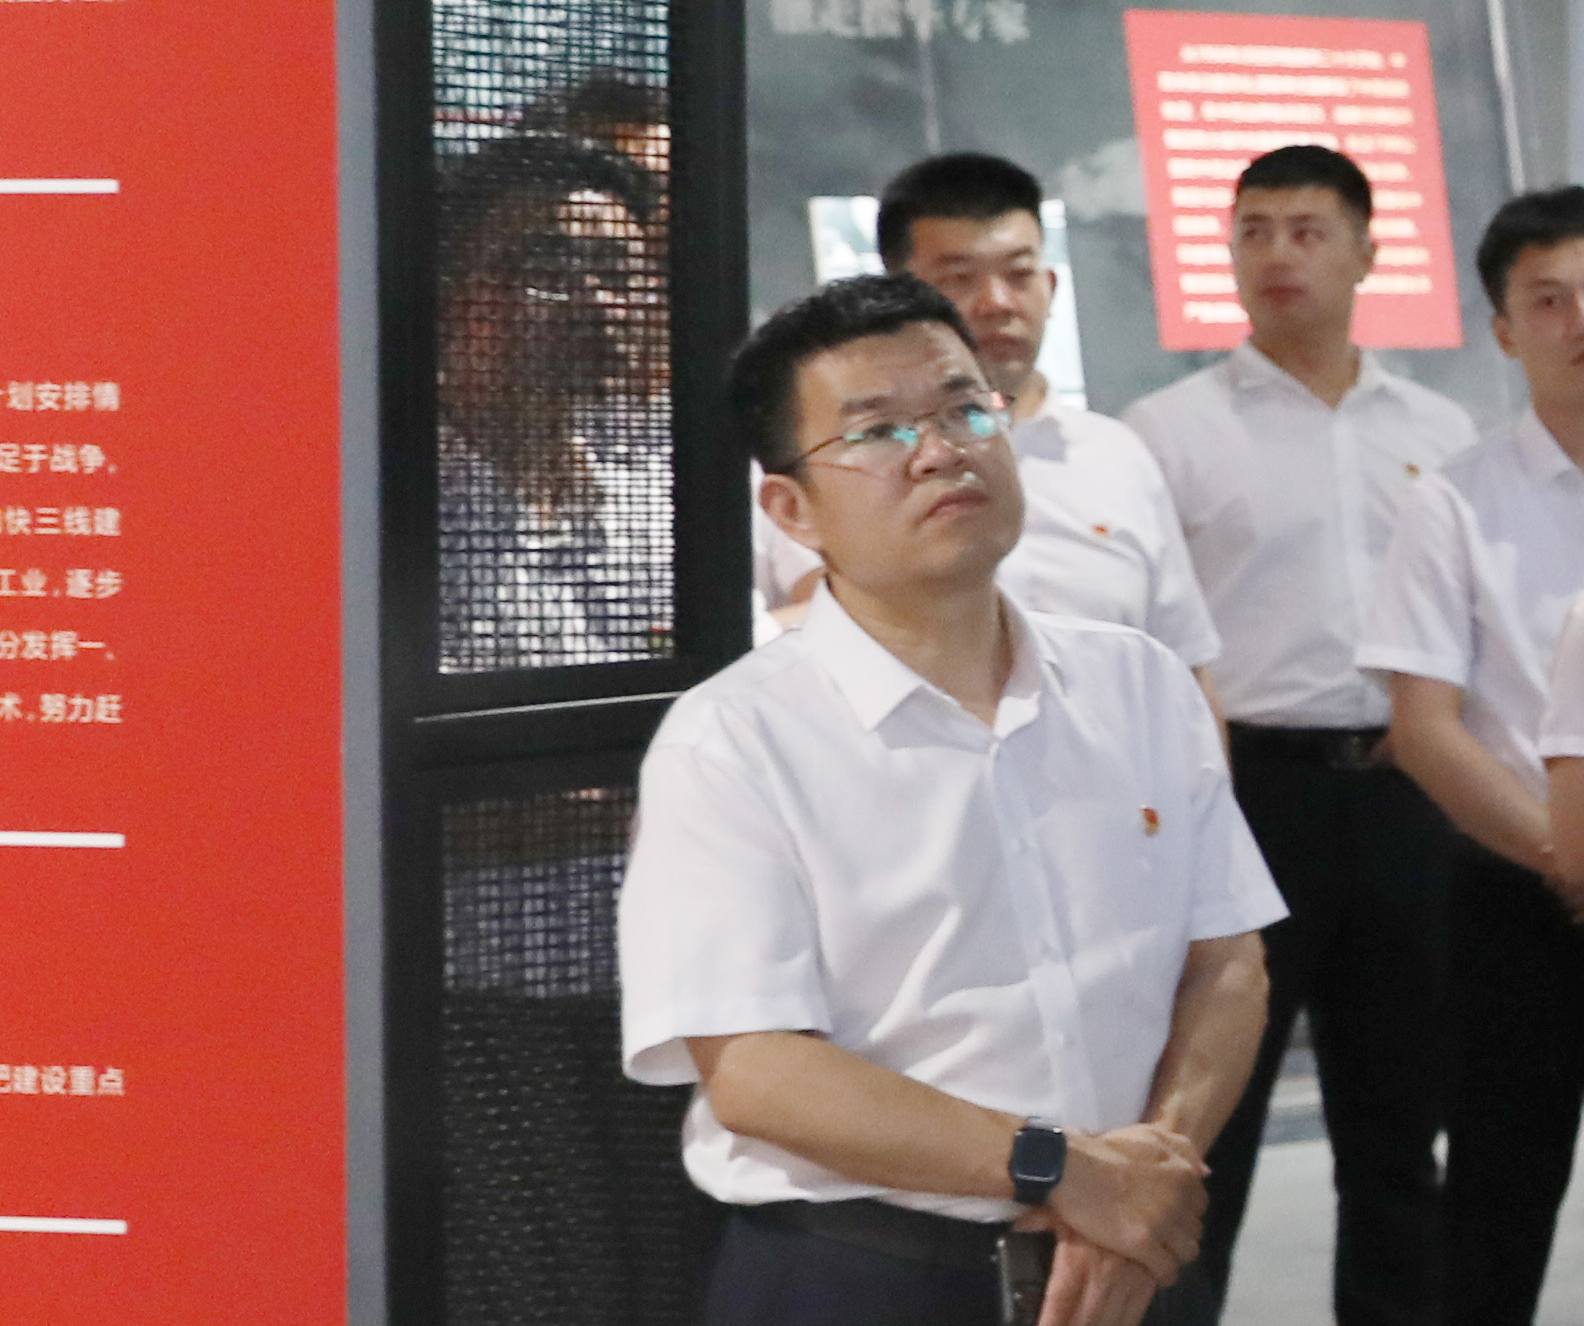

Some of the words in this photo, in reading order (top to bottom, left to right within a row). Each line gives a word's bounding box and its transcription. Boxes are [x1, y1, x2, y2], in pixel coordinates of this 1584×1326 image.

[0, 380, 121, 411] 划安排情
[0, 505, 122, 536] 快三线建
